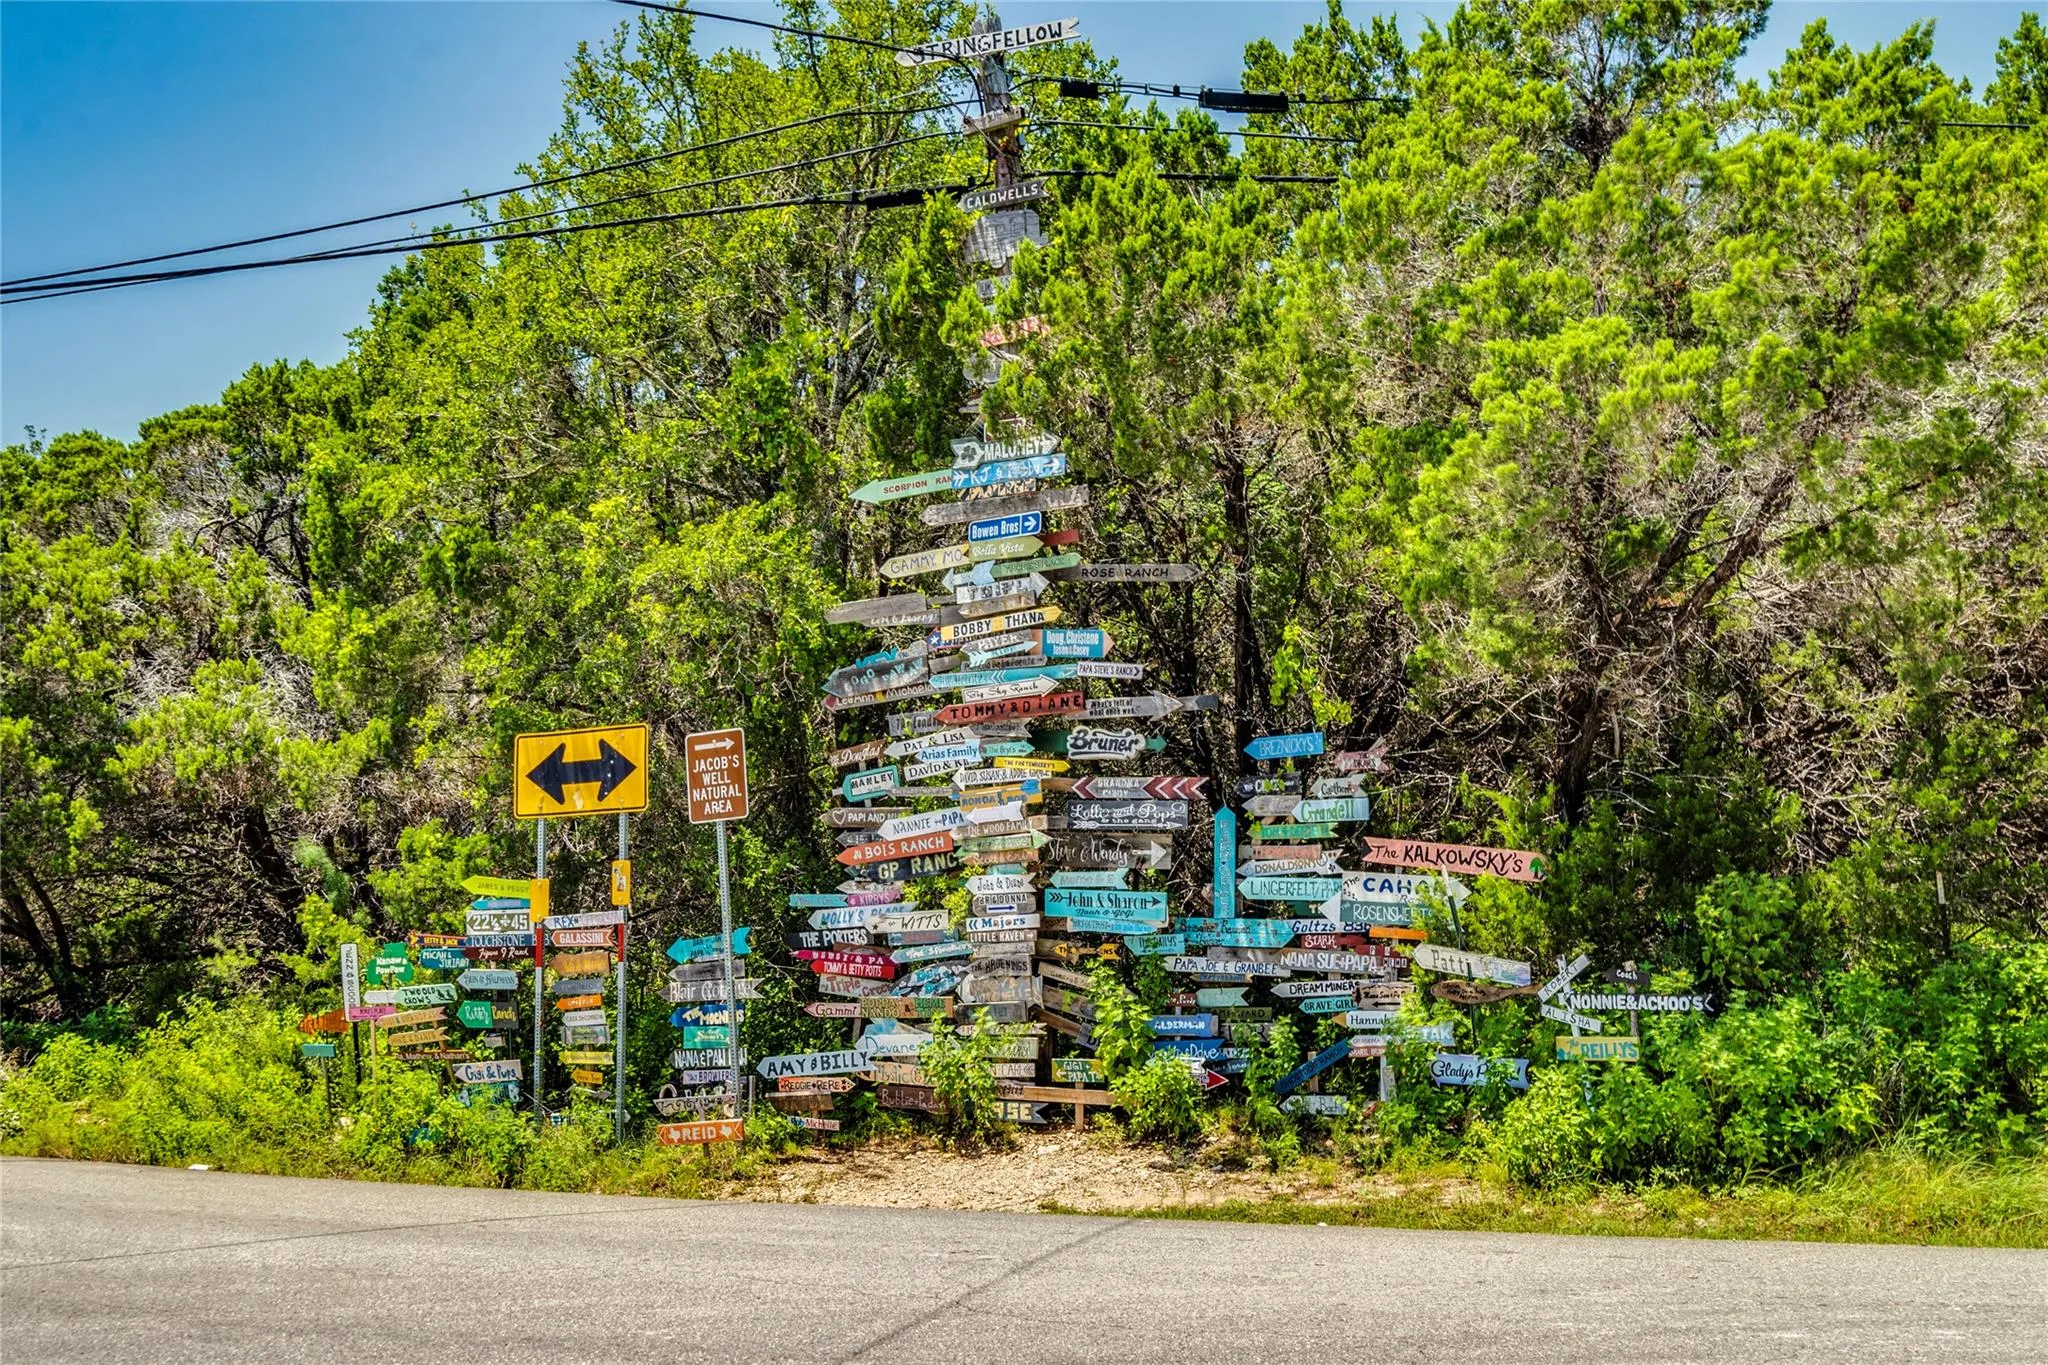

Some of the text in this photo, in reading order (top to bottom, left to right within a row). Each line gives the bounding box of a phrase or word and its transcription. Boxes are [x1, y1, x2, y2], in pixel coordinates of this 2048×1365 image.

[906, 22, 1063, 64] STRINGFELLOW
[966, 183, 1039, 209] CALDWELLS
[883, 478, 928, 495] SCORPION
[973, 519, 1019, 541] Bowen Bros
[972, 541, 1024, 558] Bella Vista
[890, 552, 935, 574] GAMMY
[1081, 567, 1169, 579] ROSE RANCH
[953, 611, 1045, 638] BOBBY THANA
[1079, 664, 1133, 676] PAPA STEVE'S RANCH
[903, 741, 923, 752] PAT
[944, 731, 965, 743] LISA
[1070, 728, 1140, 751] Bruner
[921, 745, 978, 760] Arias Family
[693, 755, 740, 773] JACOB'S
[909, 763, 942, 778] DAVID
[702, 771, 731, 786] WELL
[693, 784, 742, 802] NATURAL
[704, 800, 733, 815] AREA
[893, 811, 964, 836] NANNIE PAPA
[983, 820, 1005, 834] WOOD
[866, 842, 895, 859] BOIS
[901, 836, 945, 854] RANCH
[1371, 845, 1400, 859] The
[880, 861, 899, 880] GP
[820, 910, 864, 927] MOLLY'S
[900, 914, 942, 931] WITTS
[471, 934, 525, 948] TOUCHSTONE
[560, 933, 604, 945] GALASSINI
[799, 929, 868, 948] THE PORTERS
[970, 930, 1025, 942] LITTLE HAVEN
[422, 950, 447, 960] MICAH
[1280, 953, 1314, 969] NANA
[1173, 957, 1199, 971] PAPA
[1201, 959, 1218, 972] JOE
[1543, 962, 1579, 997] ROBERT
[1616, 969, 1638, 981] Coach
[404, 986, 437, 996] TWO OLD
[670, 982, 697, 1002] Blair
[1289, 981, 1325, 997] DREAM
[1303, 1001, 1332, 1012] BRAVE
[1545, 1006, 1591, 1028] ALISHA
[674, 1050, 700, 1069] NANA
[767, 1057, 807, 1077] AMY
[820, 1050, 868, 1072] BILLY
[486, 1066, 496, 1079] &
[784, 1080, 840, 1091] REGGIE RERE
[681, 1126, 717, 1141] REID
